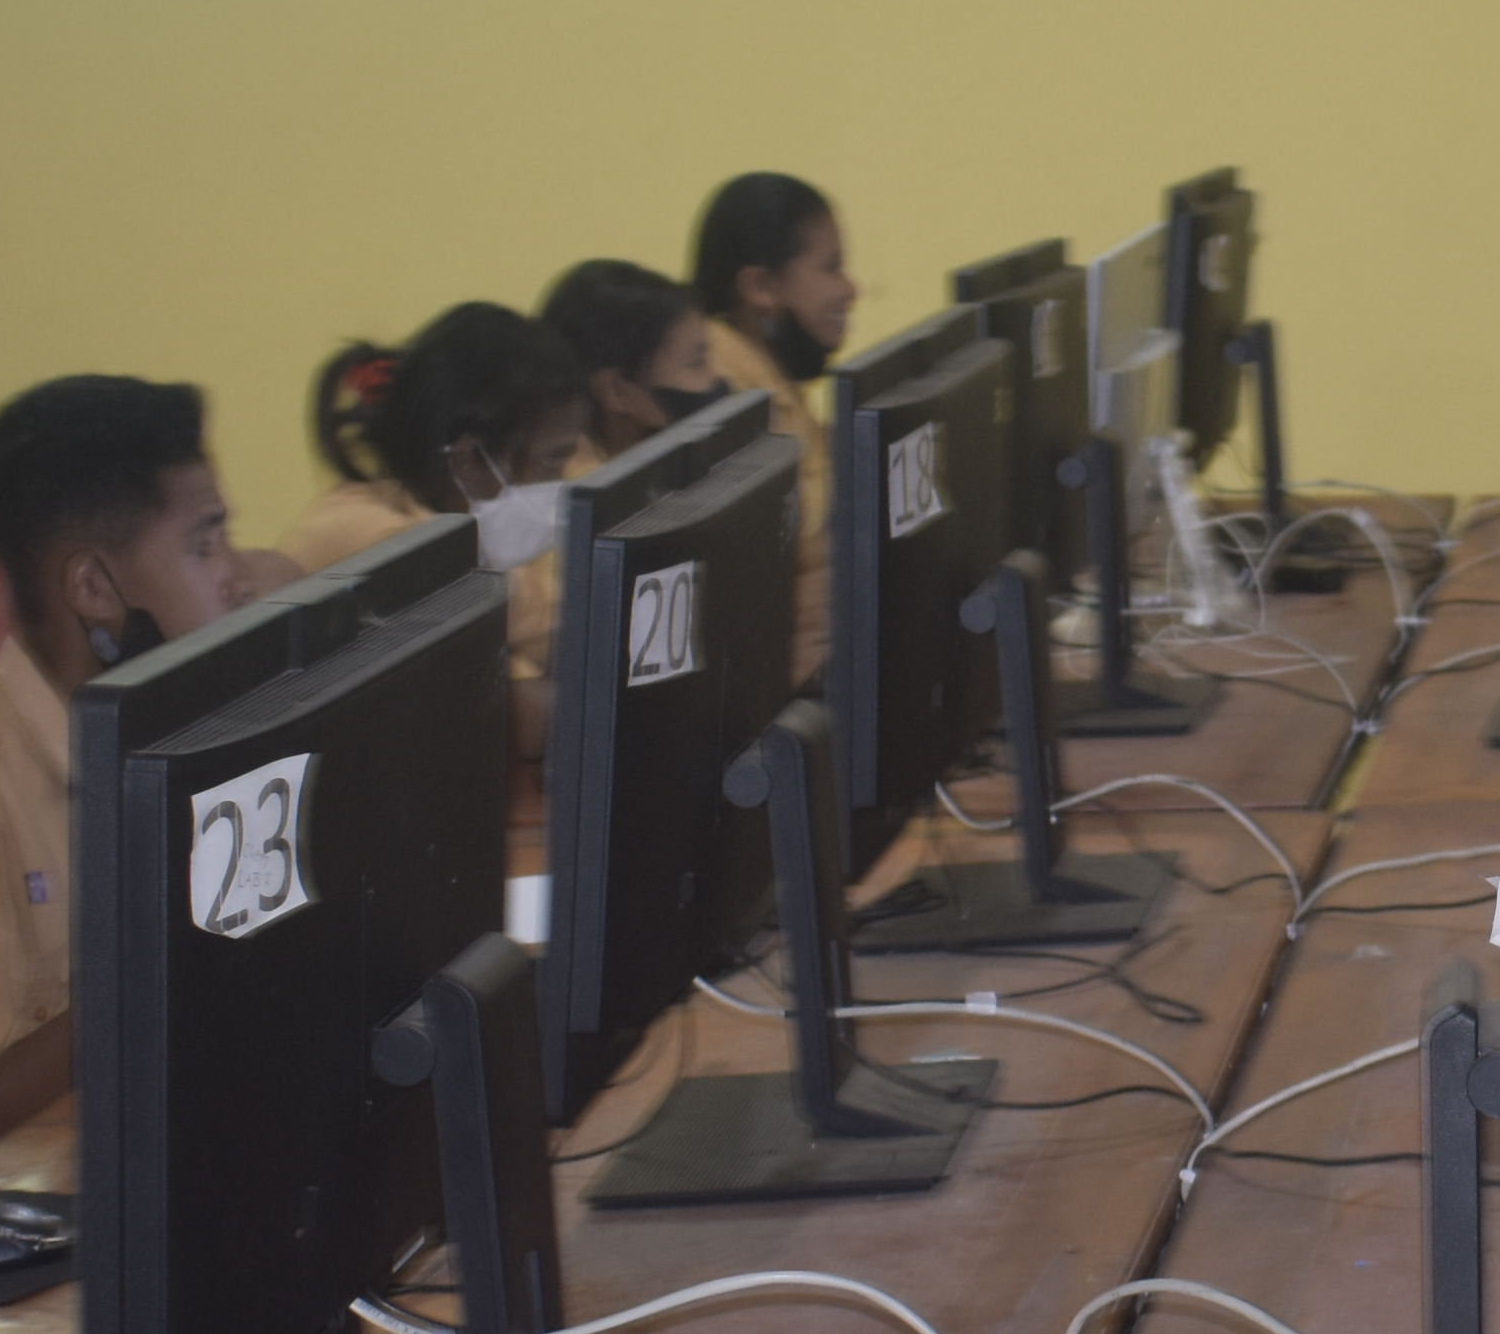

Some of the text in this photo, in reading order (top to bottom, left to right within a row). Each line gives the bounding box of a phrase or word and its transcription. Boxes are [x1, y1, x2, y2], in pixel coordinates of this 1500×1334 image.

[893, 434, 933, 526] 18
[632, 572, 690, 677] 20
[202, 777, 292, 934] 23
